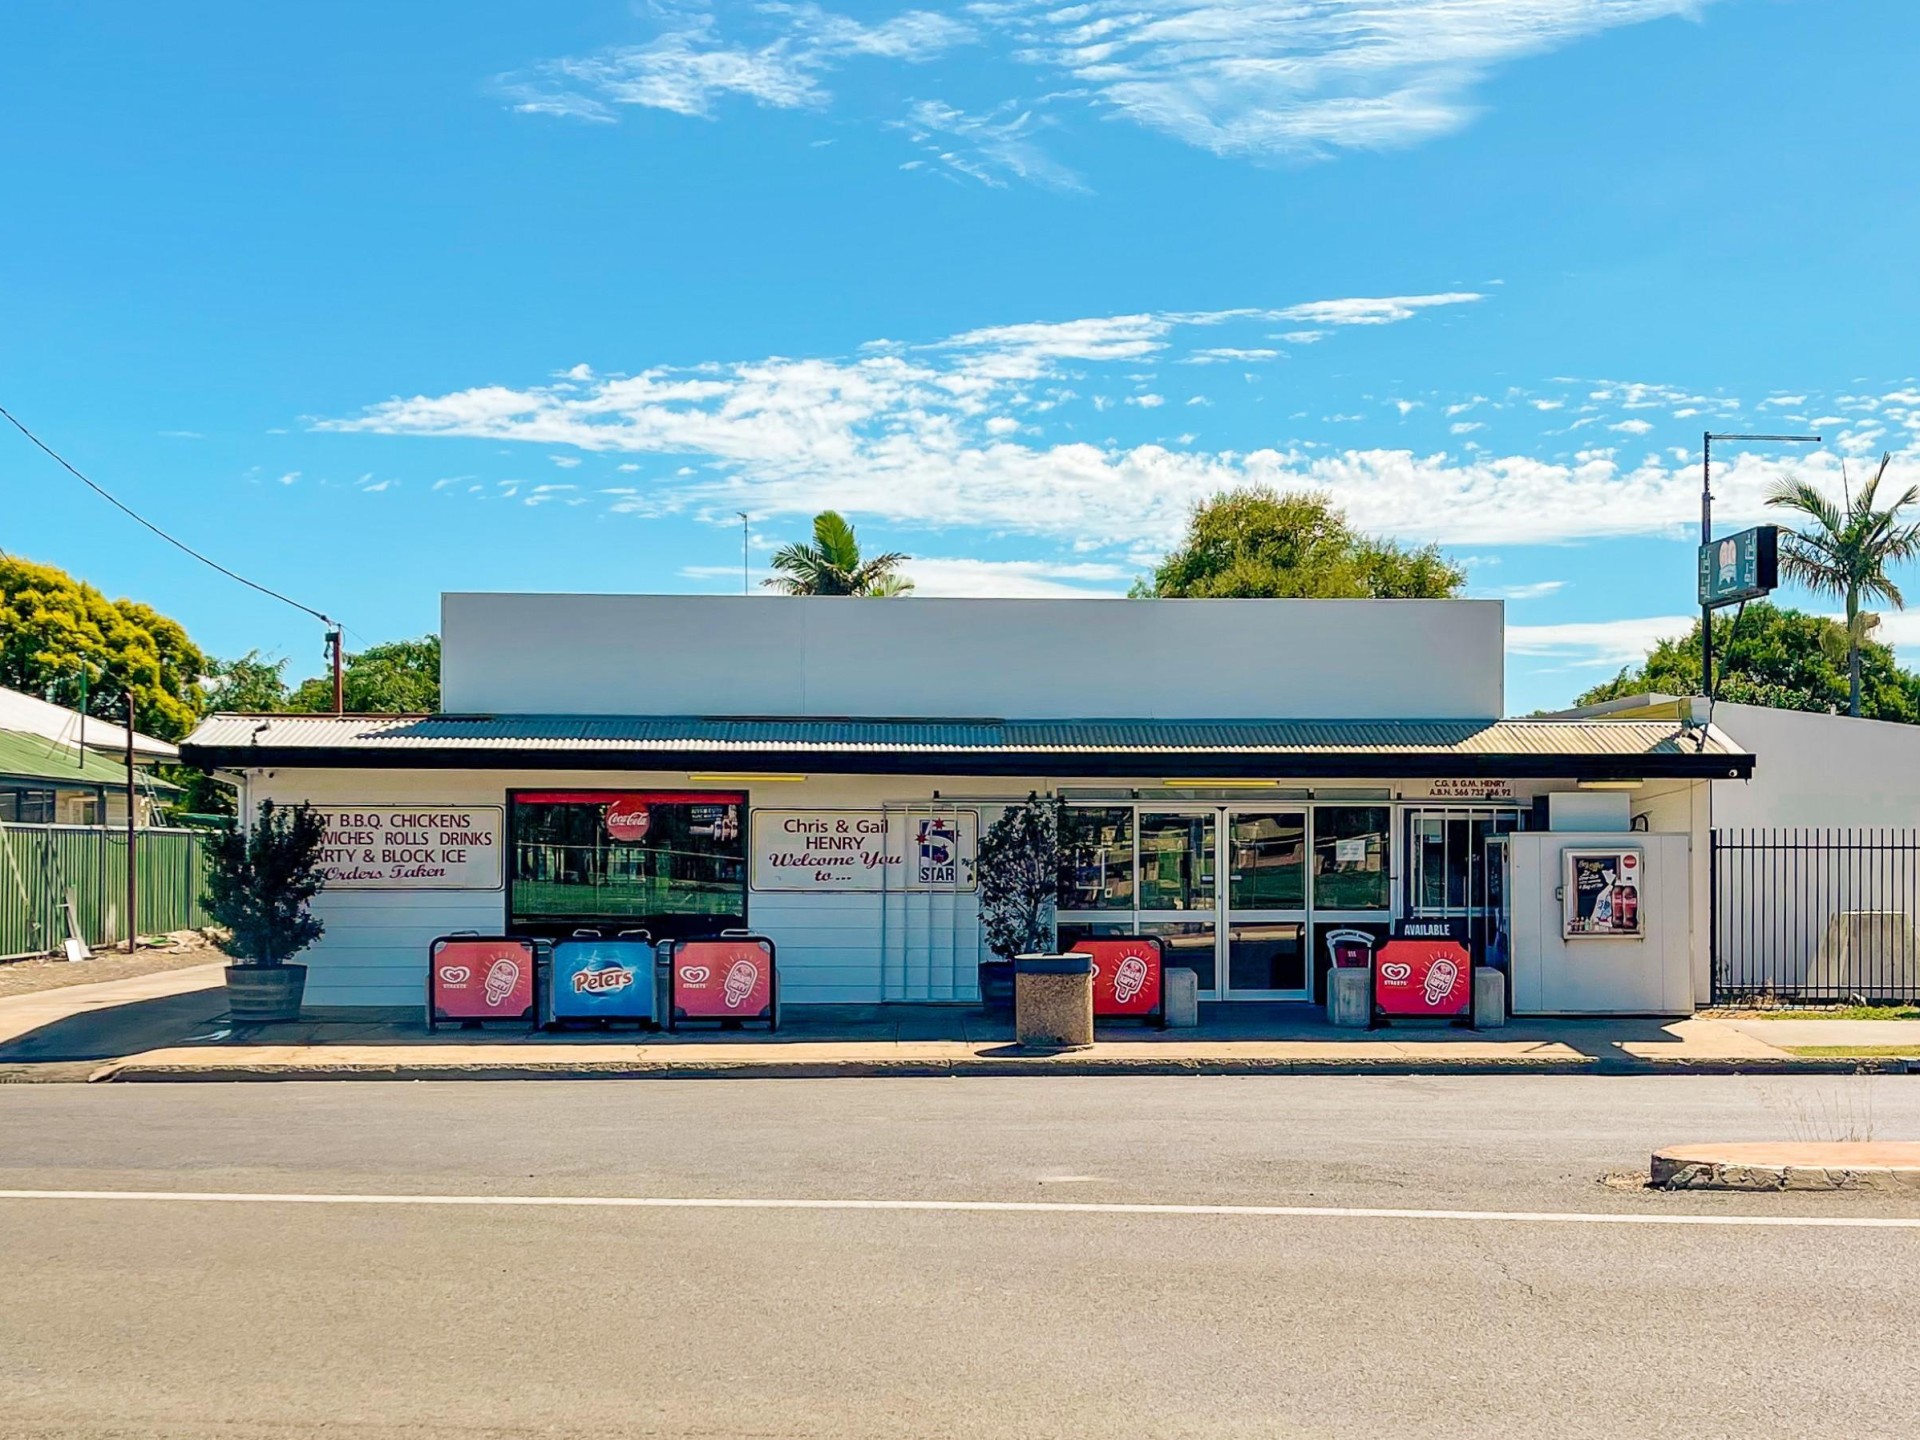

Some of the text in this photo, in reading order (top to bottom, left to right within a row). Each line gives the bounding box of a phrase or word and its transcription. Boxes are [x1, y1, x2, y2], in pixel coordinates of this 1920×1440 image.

[1429, 788, 1452, 796] A.B.N.
[1471, 788, 1484, 796] 732
[1501, 788, 1512, 796] 92
[340, 813, 383, 830] B.B.Q.
[390, 813, 471, 829] CHICKENS
[783, 819, 889, 833] Chris & Gail
[384, 831, 429, 846] ROLLS
[440, 831, 492, 846] DRINKS
[806, 836, 866, 850] HENRY
[309, 848, 467, 863] ARTY & BLOCK ICE
[769, 851, 903, 869] Welcome You
[323, 864, 447, 881] Orders Taken
[921, 866, 954, 881] STAR
[1404, 923, 1451, 936] AVAILABLE
[573, 971, 632, 992] Peters
